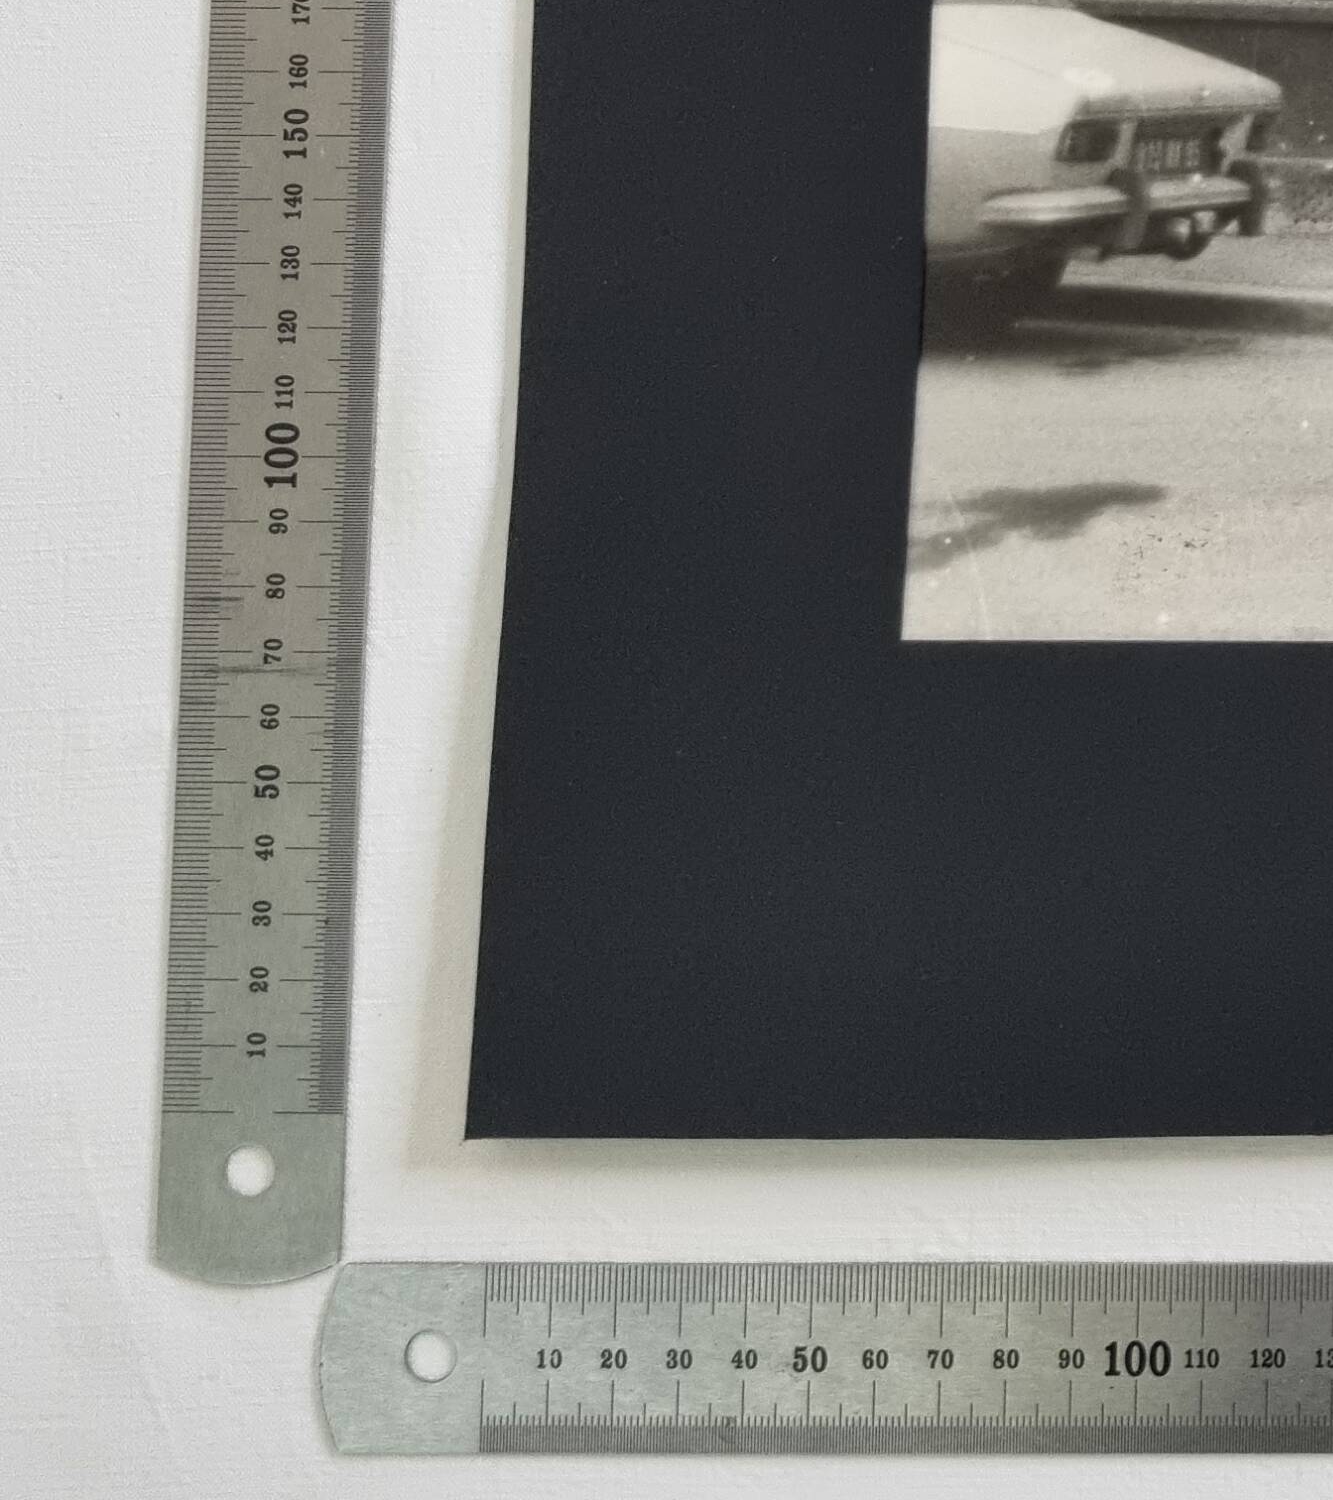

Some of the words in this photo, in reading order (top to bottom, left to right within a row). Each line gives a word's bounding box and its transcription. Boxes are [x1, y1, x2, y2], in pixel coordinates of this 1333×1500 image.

[288, 53, 309, 89] 160
[282, 108, 310, 159] 150
[282, 183, 304, 220] 140
[279, 244, 301, 281] 130
[276, 309, 298, 345] 120
[273, 374, 295, 409] 110
[263, 422, 301, 489] 100
[267, 507, 289, 535] 90
[264, 572, 286, 600] 80
[262, 638, 284, 665] 70
[259, 703, 281, 731] 60
[253, 764, 281, 800] 50
[254, 834, 275, 862] 40
[251, 899, 273, 928] 30
[248, 965, 270, 994] 20
[245, 1032, 268, 1058] 10
[536, 1348, 563, 1370] 10
[599, 1348, 628, 1370] 20
[665, 1348, 693, 1370] 30
[730, 1348, 759, 1370] 40
[791, 1345, 828, 1374] 50
[861, 1348, 889, 1370] 60
[926, 1348, 955, 1370] 70
[992, 1348, 1020, 1370] 80
[1058, 1348, 1086, 1370] 90
[1104, 1339, 1172, 1378] 100
[1184, 1348, 1220, 1369] 110
[1249, 1347, 1286, 1369] 120
